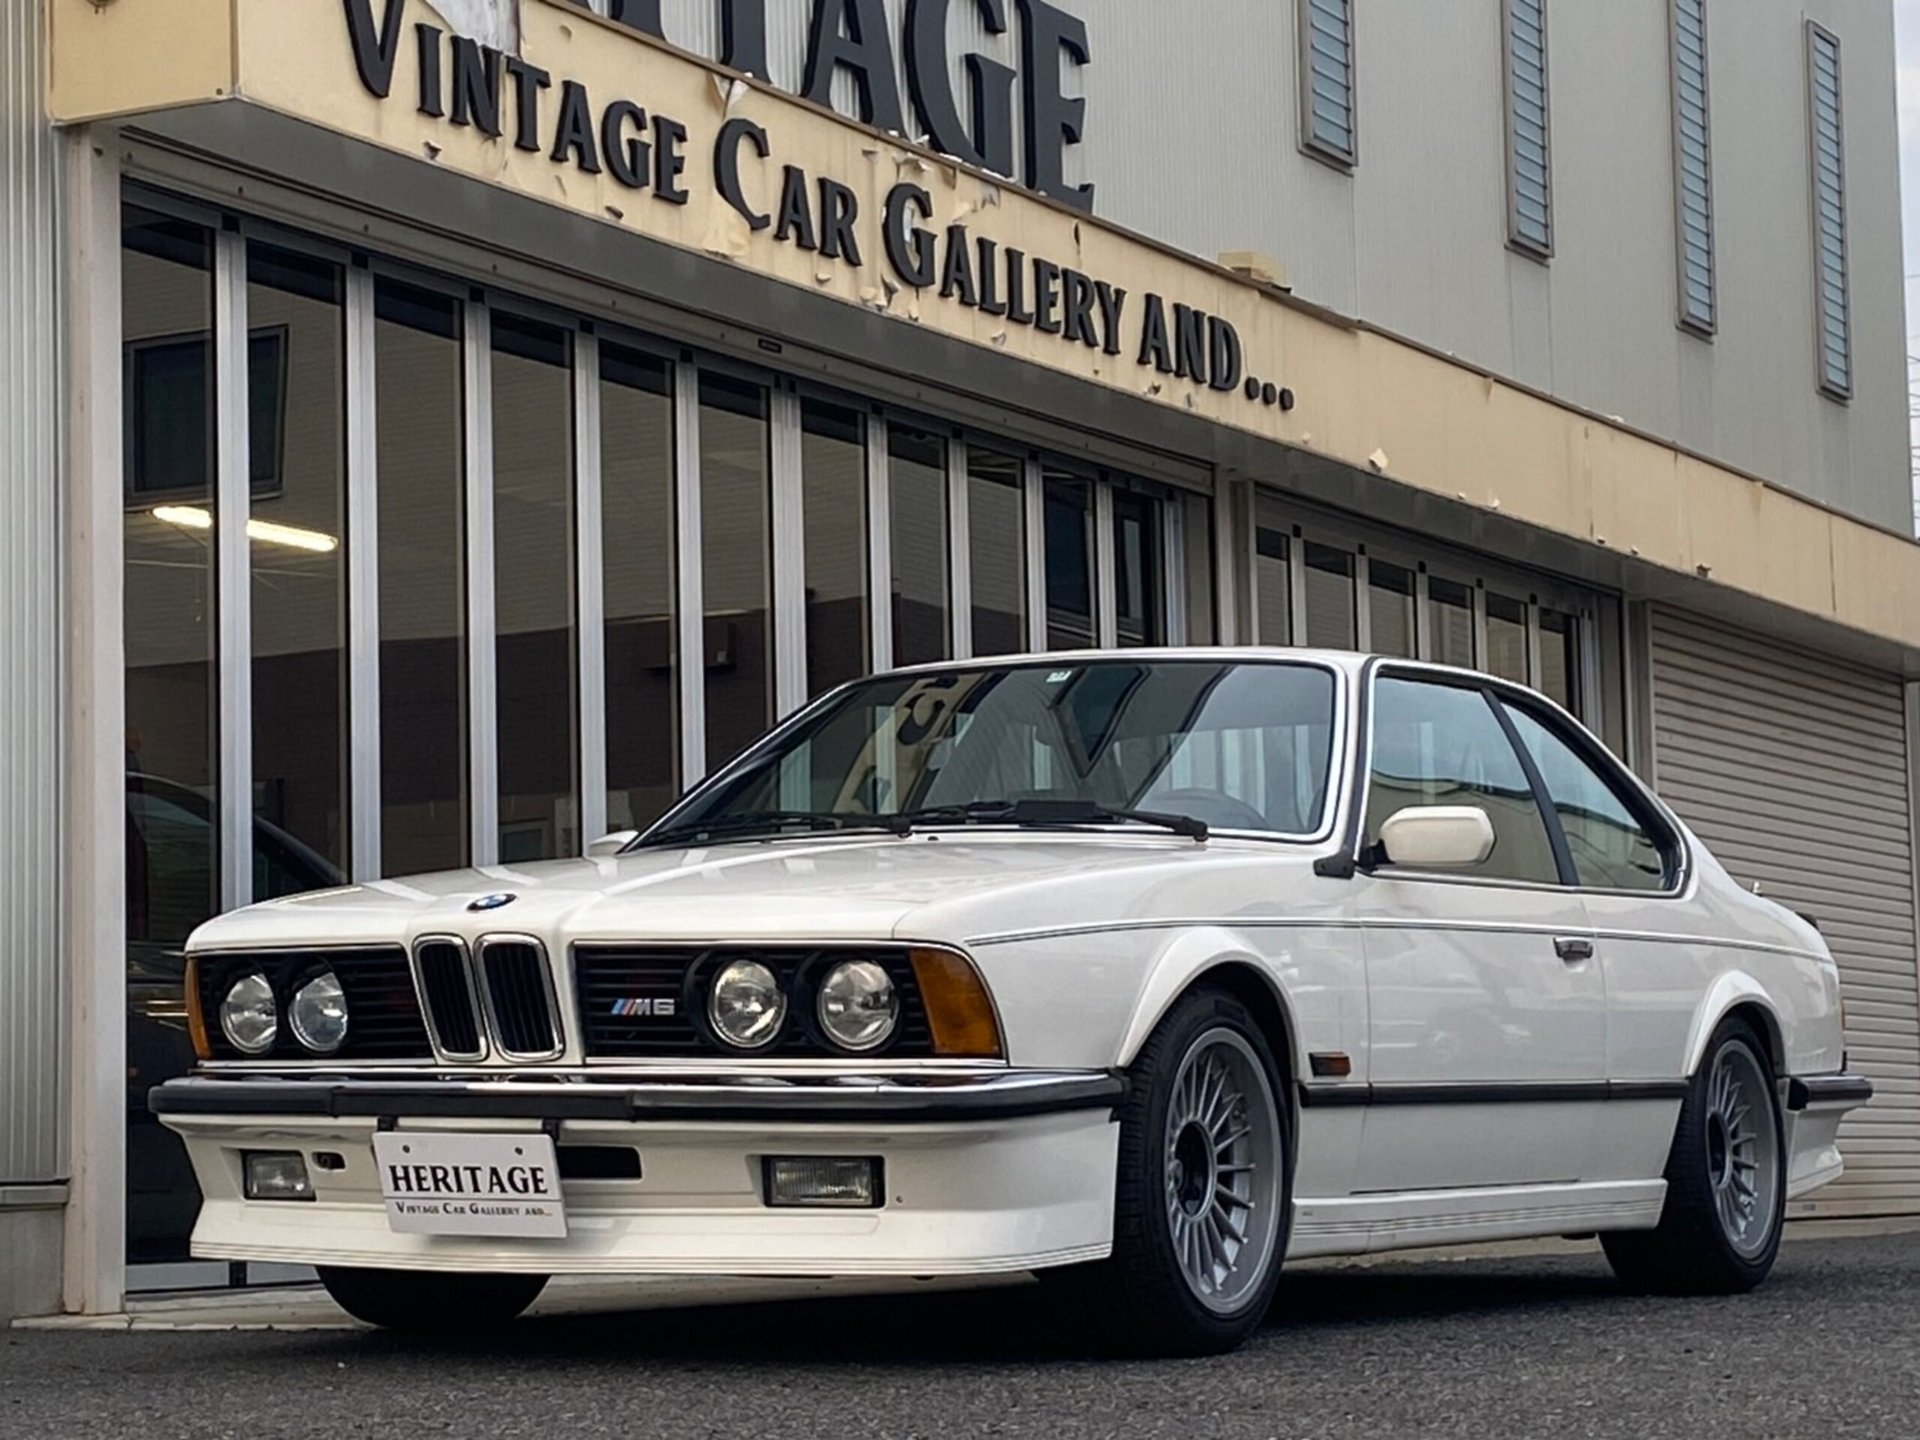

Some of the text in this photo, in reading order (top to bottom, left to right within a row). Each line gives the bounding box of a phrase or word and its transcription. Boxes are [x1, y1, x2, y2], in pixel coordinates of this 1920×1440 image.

[343, 0, 690, 206] VINTAGE
[713, 117, 862, 267] CAR
[883, 182, 1127, 355] GALLERY
[388, 1164, 548, 1195] HERITAGE
[442, 1202, 467, 1215] CAR
